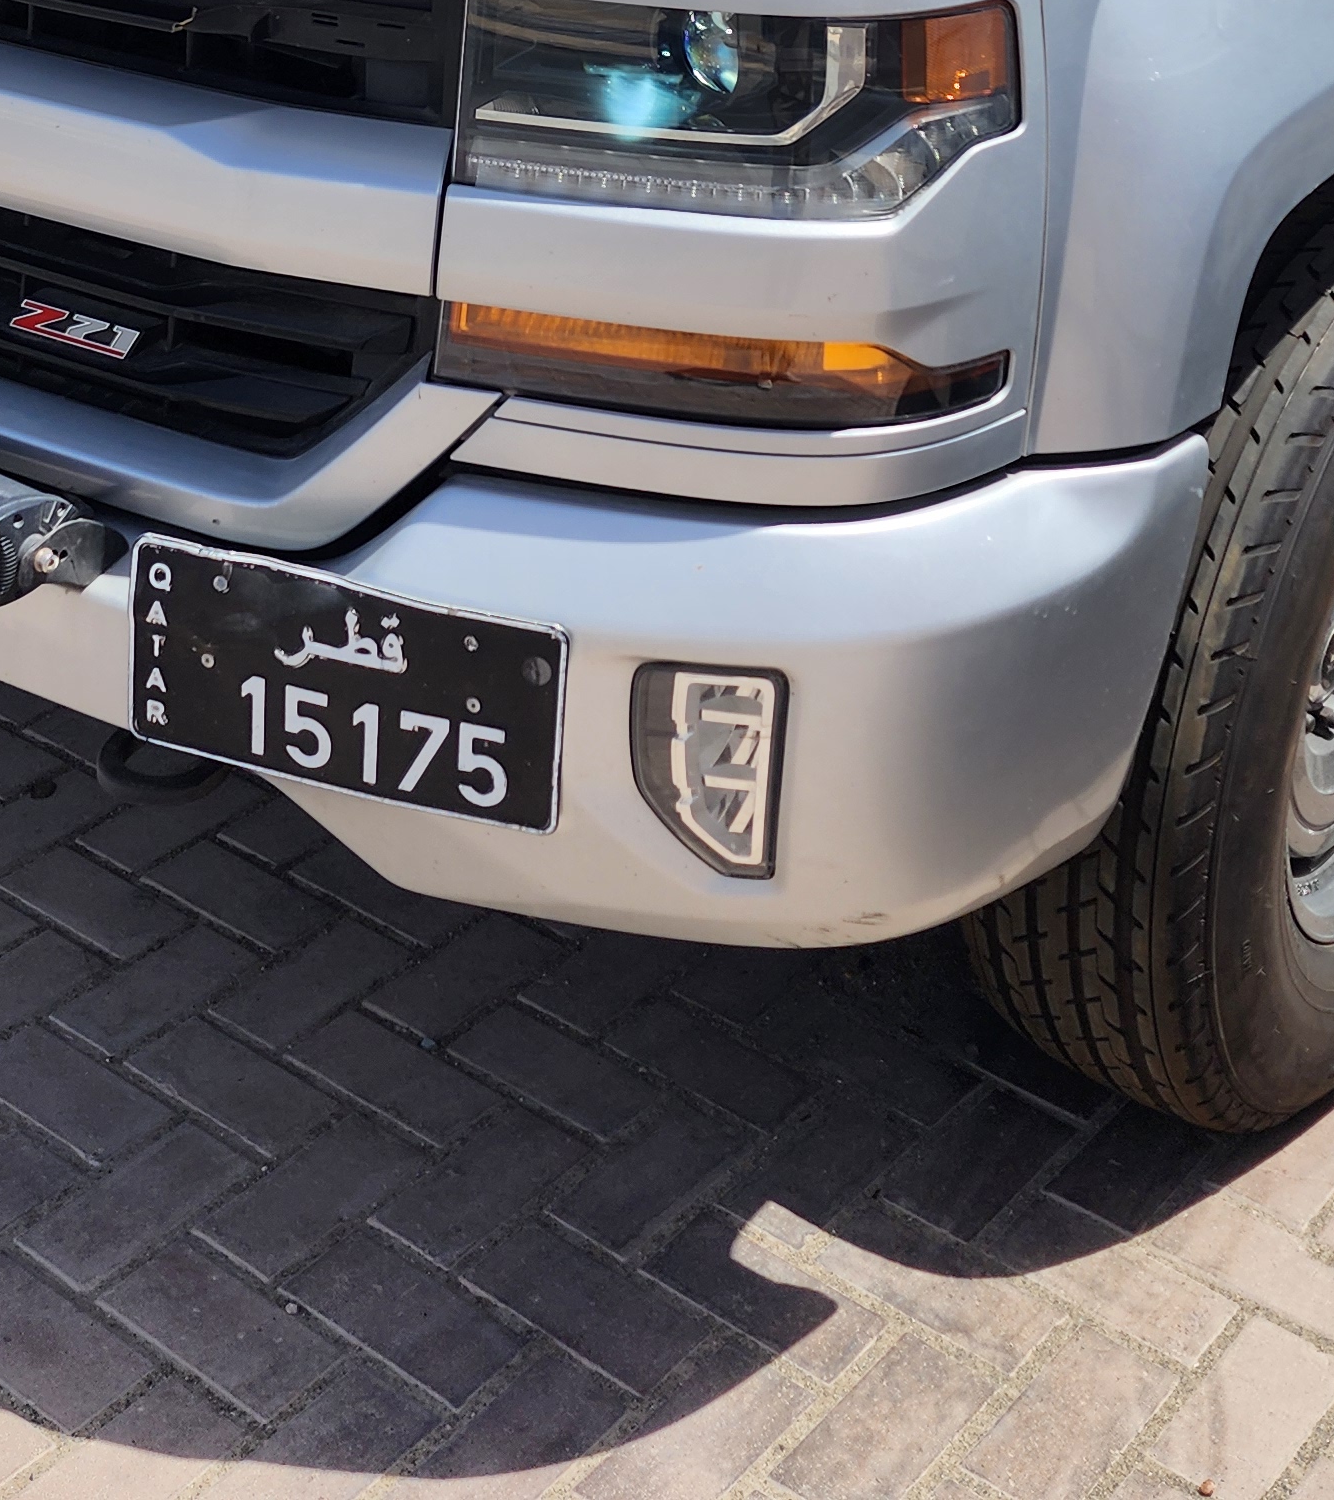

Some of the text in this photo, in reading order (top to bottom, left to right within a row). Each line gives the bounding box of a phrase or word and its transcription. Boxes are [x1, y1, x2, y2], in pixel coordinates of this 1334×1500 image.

[9, 298, 141, 360] Z71
[146, 562, 172, 726] QATAR
[274, 608, 409, 674] قطر
[240, 675, 509, 808] 15175
